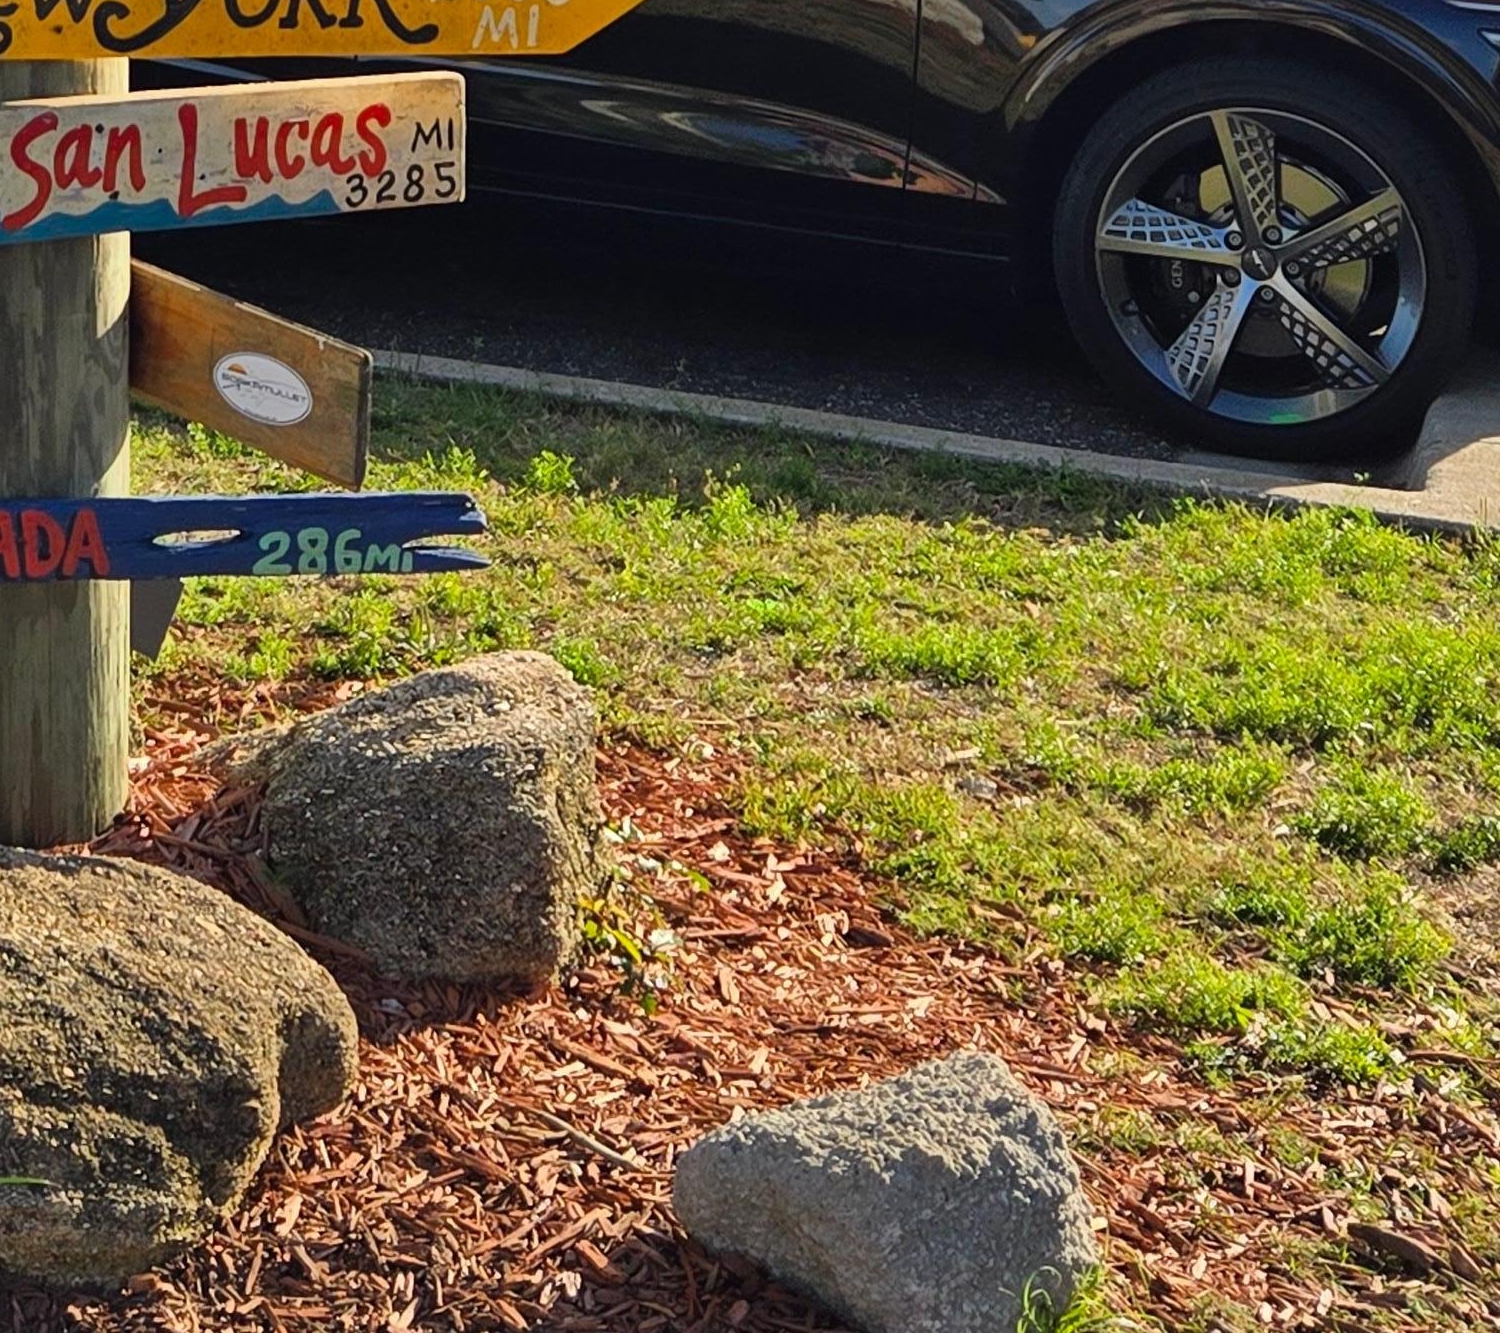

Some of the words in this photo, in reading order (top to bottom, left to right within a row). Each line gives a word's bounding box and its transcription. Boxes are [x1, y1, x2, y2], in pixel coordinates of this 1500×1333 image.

[469, 4, 541, 52] MI
[0, 107, 149, 233] San
[176, 100, 395, 219] Lucas
[409, 119, 458, 156] MI
[344, 159, 460, 210] 3285
